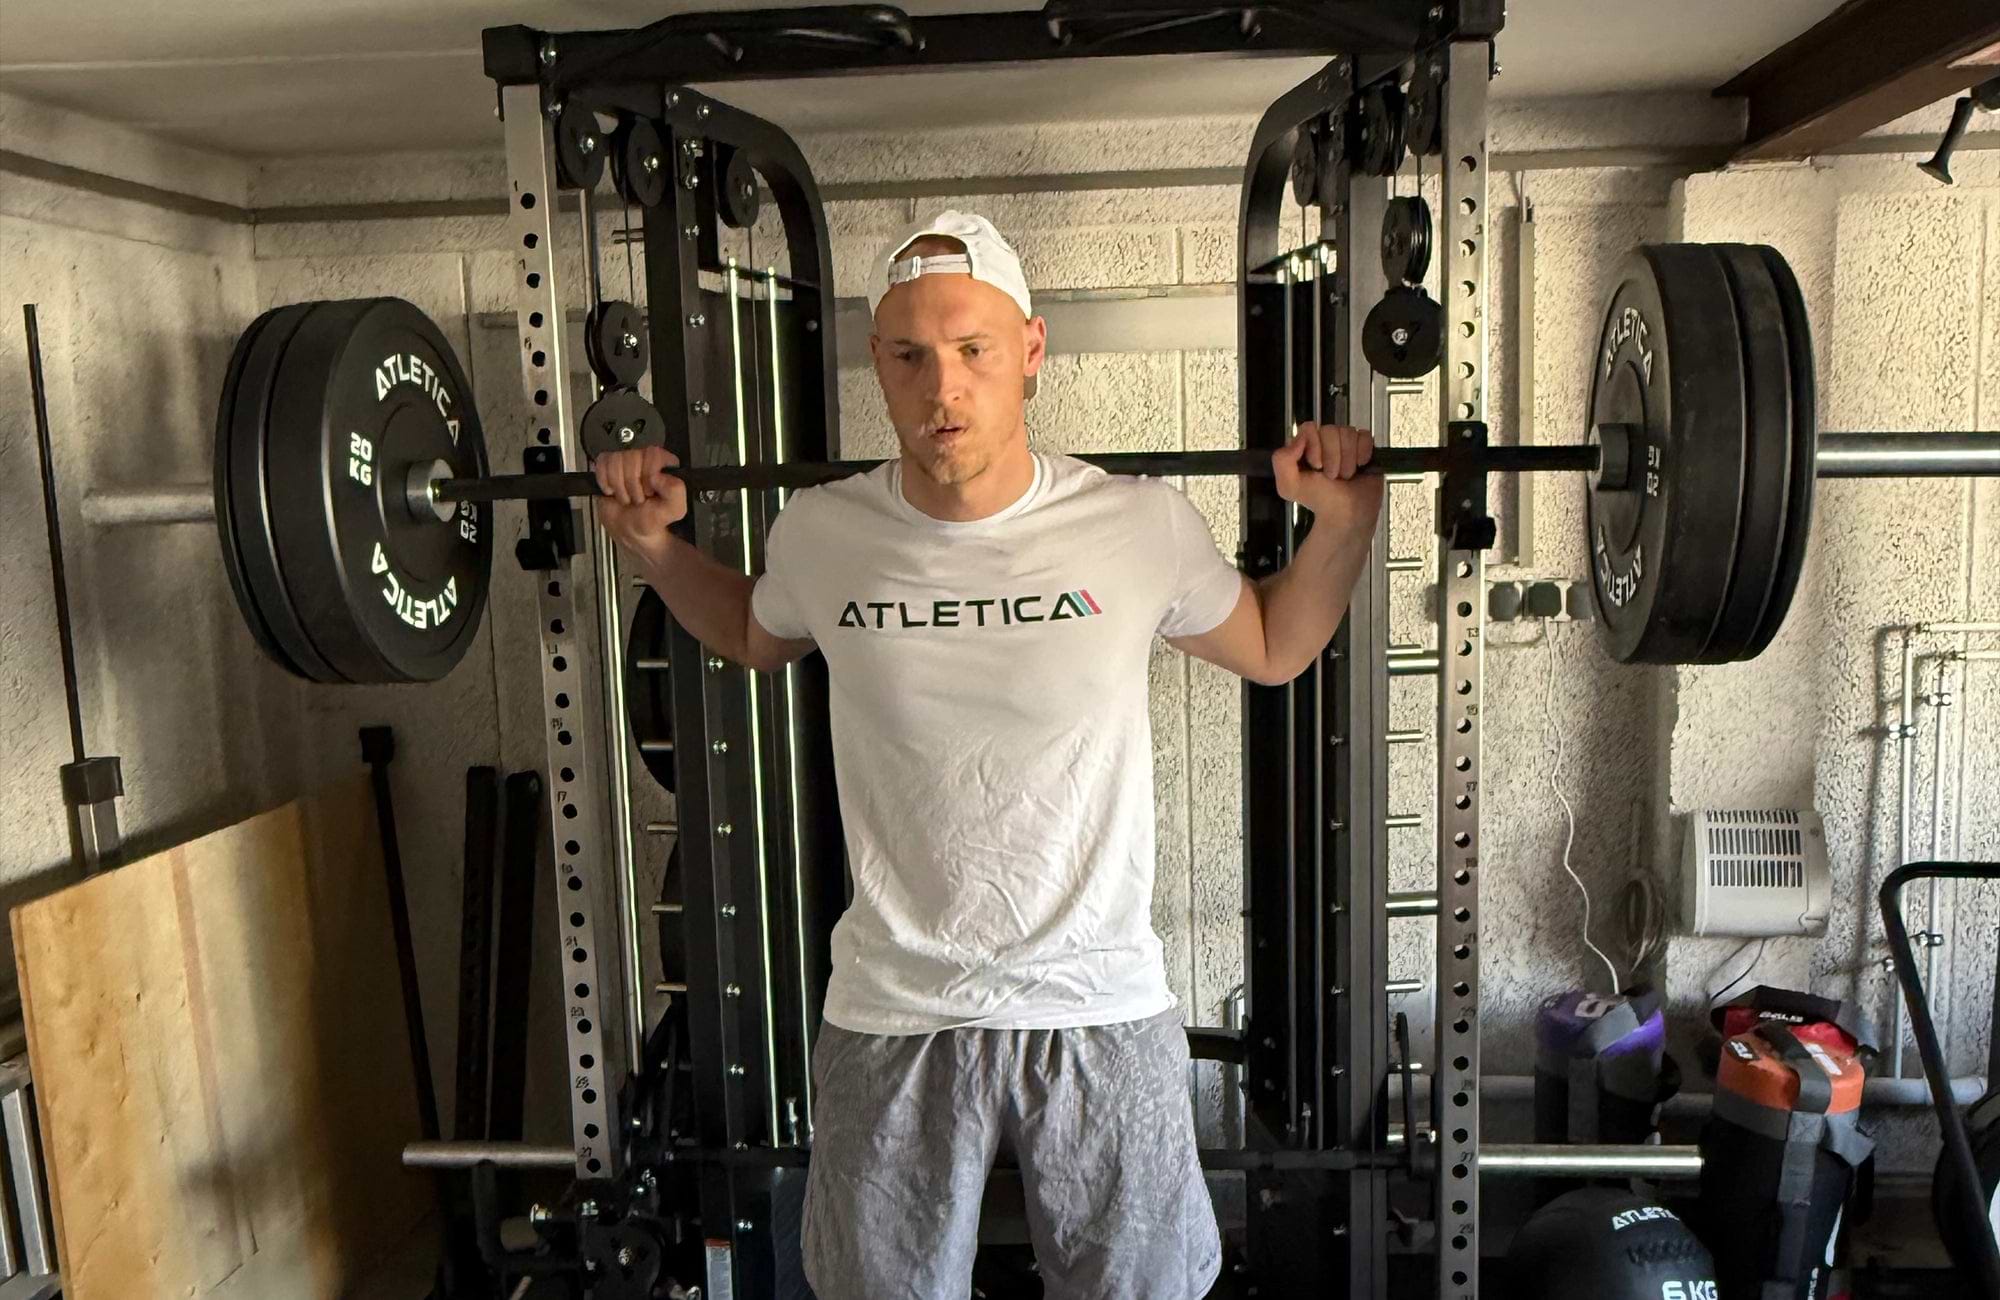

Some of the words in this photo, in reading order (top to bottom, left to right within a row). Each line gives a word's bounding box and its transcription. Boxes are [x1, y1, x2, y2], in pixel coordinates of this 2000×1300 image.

[1605, 307, 1653, 386] ATLETICA
[375, 353, 459, 447] ATLETICA
[349, 432, 373, 462] 20
[349, 457, 373, 487] KG
[371, 541, 457, 629] ATLETICA
[838, 591, 1087, 629] ATLETICA
[1662, 1280, 1687, 1300] 6
[1688, 1280, 1718, 1300] KG
